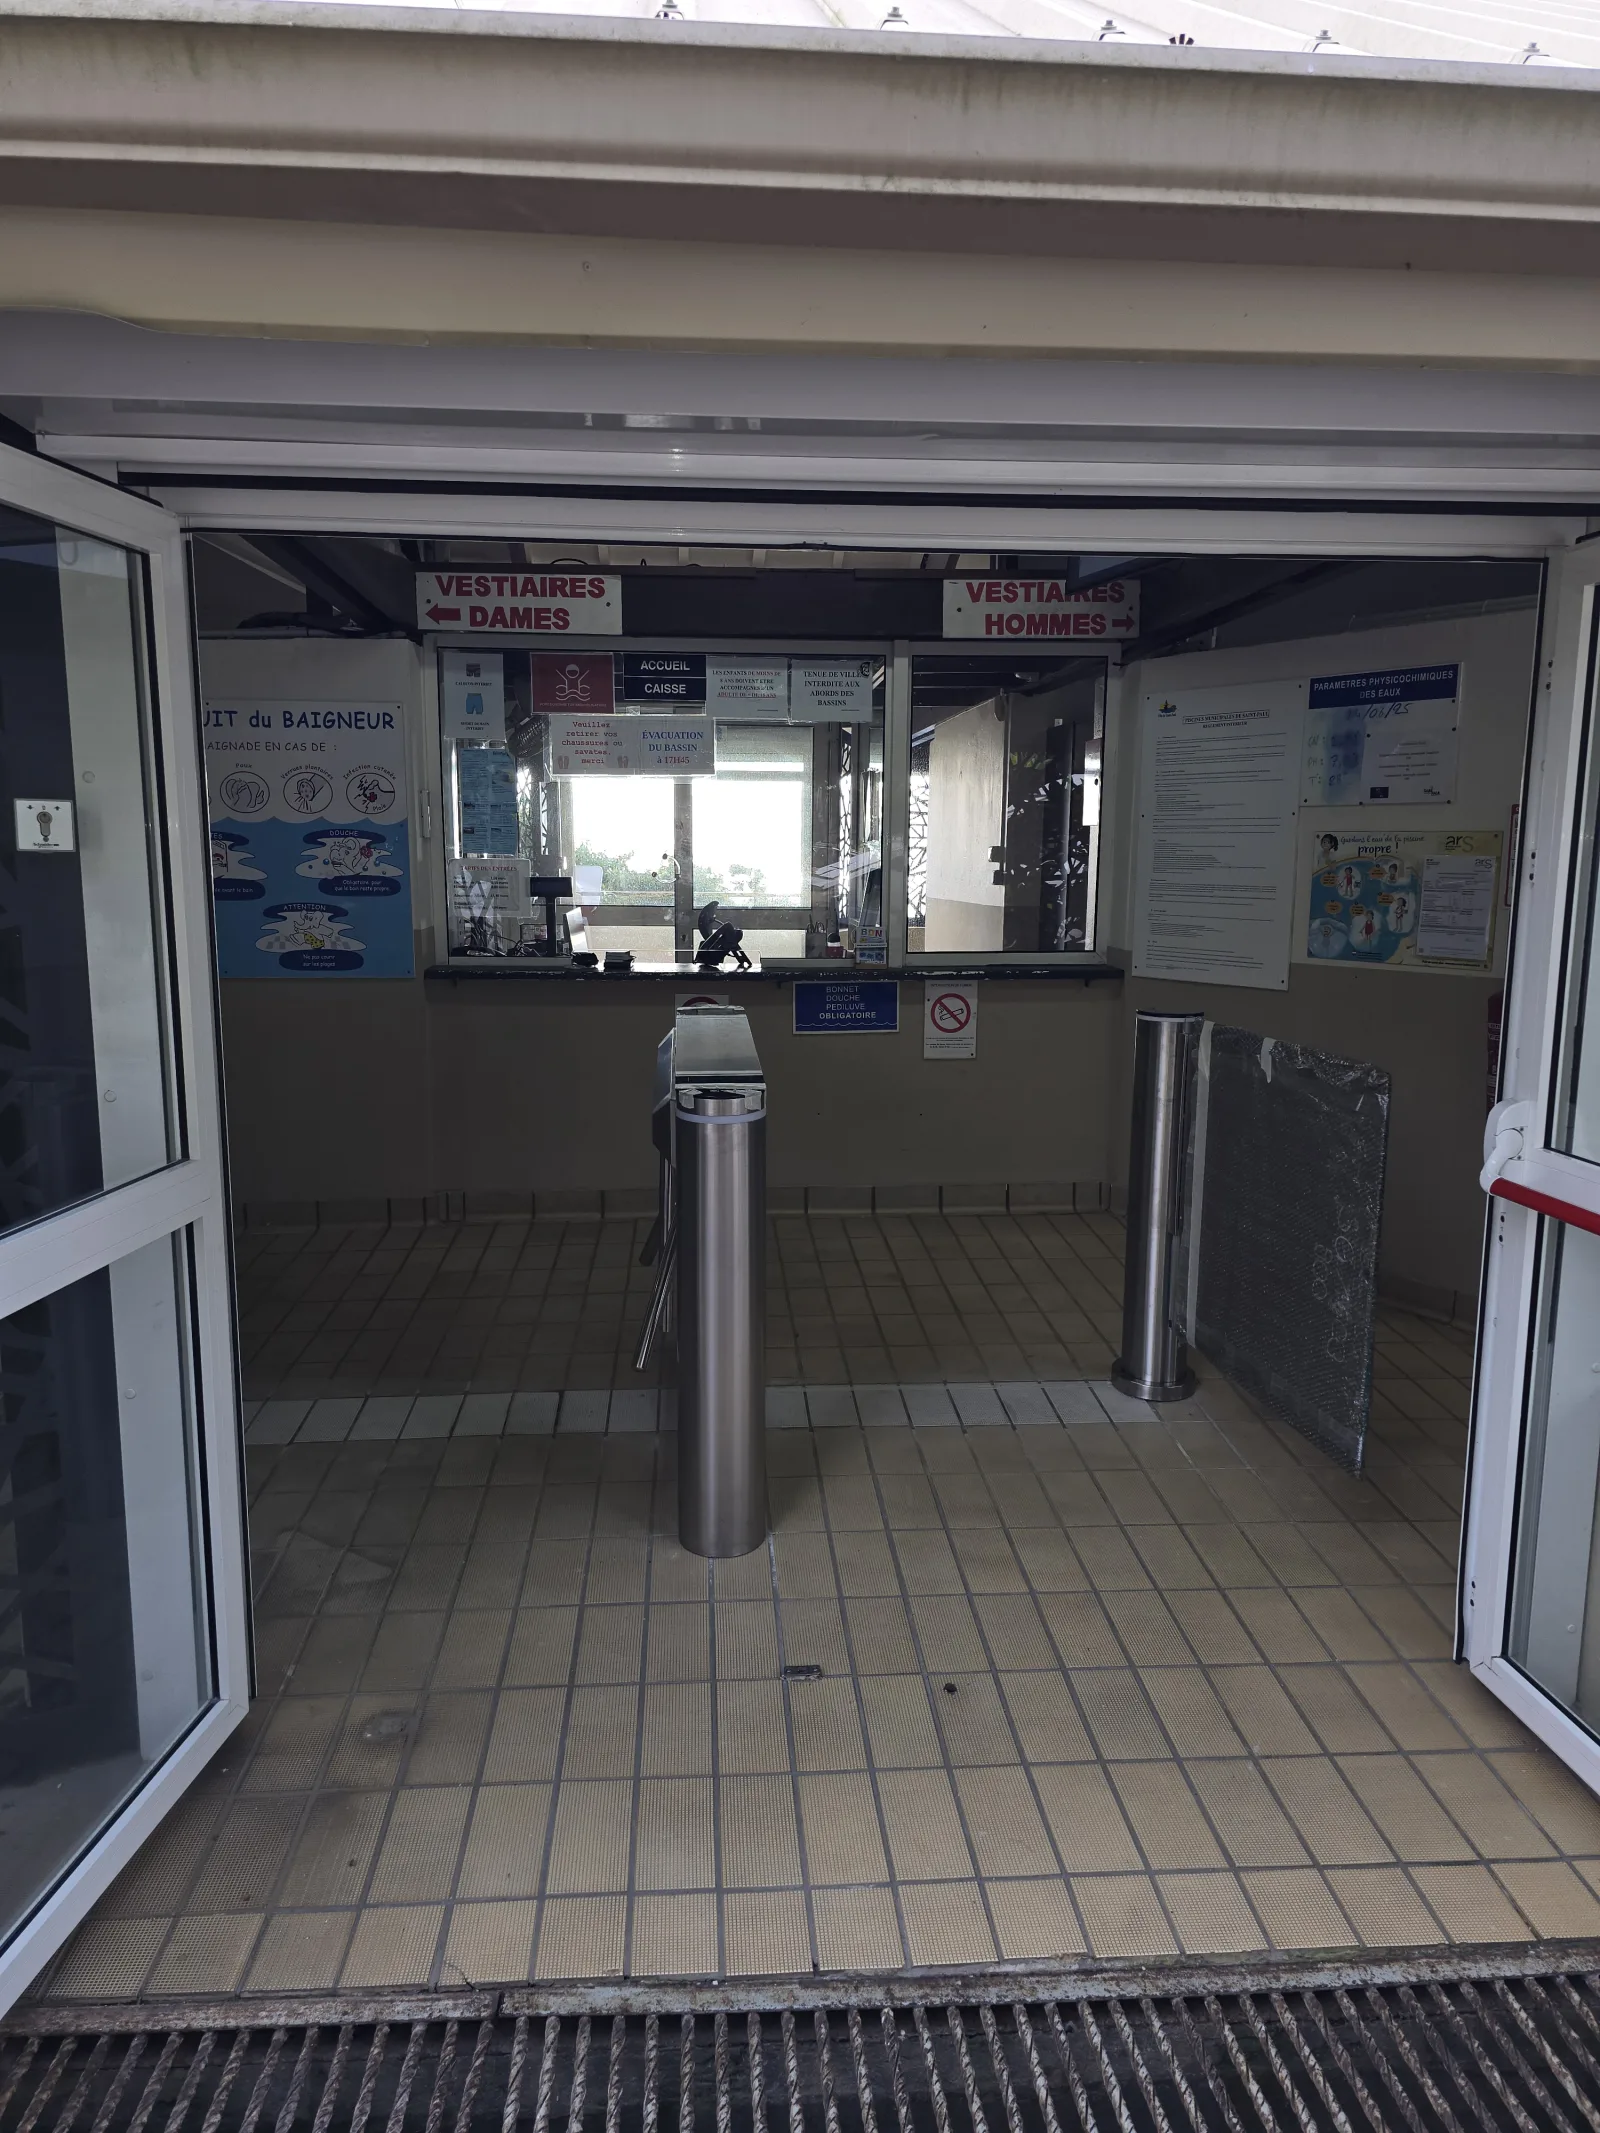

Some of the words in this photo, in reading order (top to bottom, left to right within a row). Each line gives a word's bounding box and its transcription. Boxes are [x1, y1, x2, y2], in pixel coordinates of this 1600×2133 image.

[435, 575, 605, 598] VESTIAIRES
[469, 606, 569, 630] DAMES
[985, 614, 1106, 635] HOMMES
[641, 661, 690, 670] ACCUEIL
[1314, 679, 1366, 691] PARAMETRES
[1369, 671, 1454, 686] PHYSICOCHIMIQUES
[645, 684, 686, 694] CAISSE
[1360, 690, 1375, 699] DES
[1378, 688, 1400, 697] EAUX
[249, 710, 271, 728] du
[283, 710, 394, 730] BAIGNEUR
[642, 730, 703, 739] ÉVACUATION
[207, 741, 260, 751] AIGNADE
[265, 742, 280, 751] EN
[284, 742, 307, 751] CAS
[312, 743, 326, 751] DE
[649, 744, 662, 752] DU
[664, 744, 697, 752] BASSIN
[657, 756, 662, 764] à
[280, 766, 303, 779] Verrues
[305, 764, 333, 780] plantaires
[343, 764, 371, 780] Infection
[1358, 845, 1391, 857] propre
[819, 1012, 876, 1020] OBLIGATOIRE
